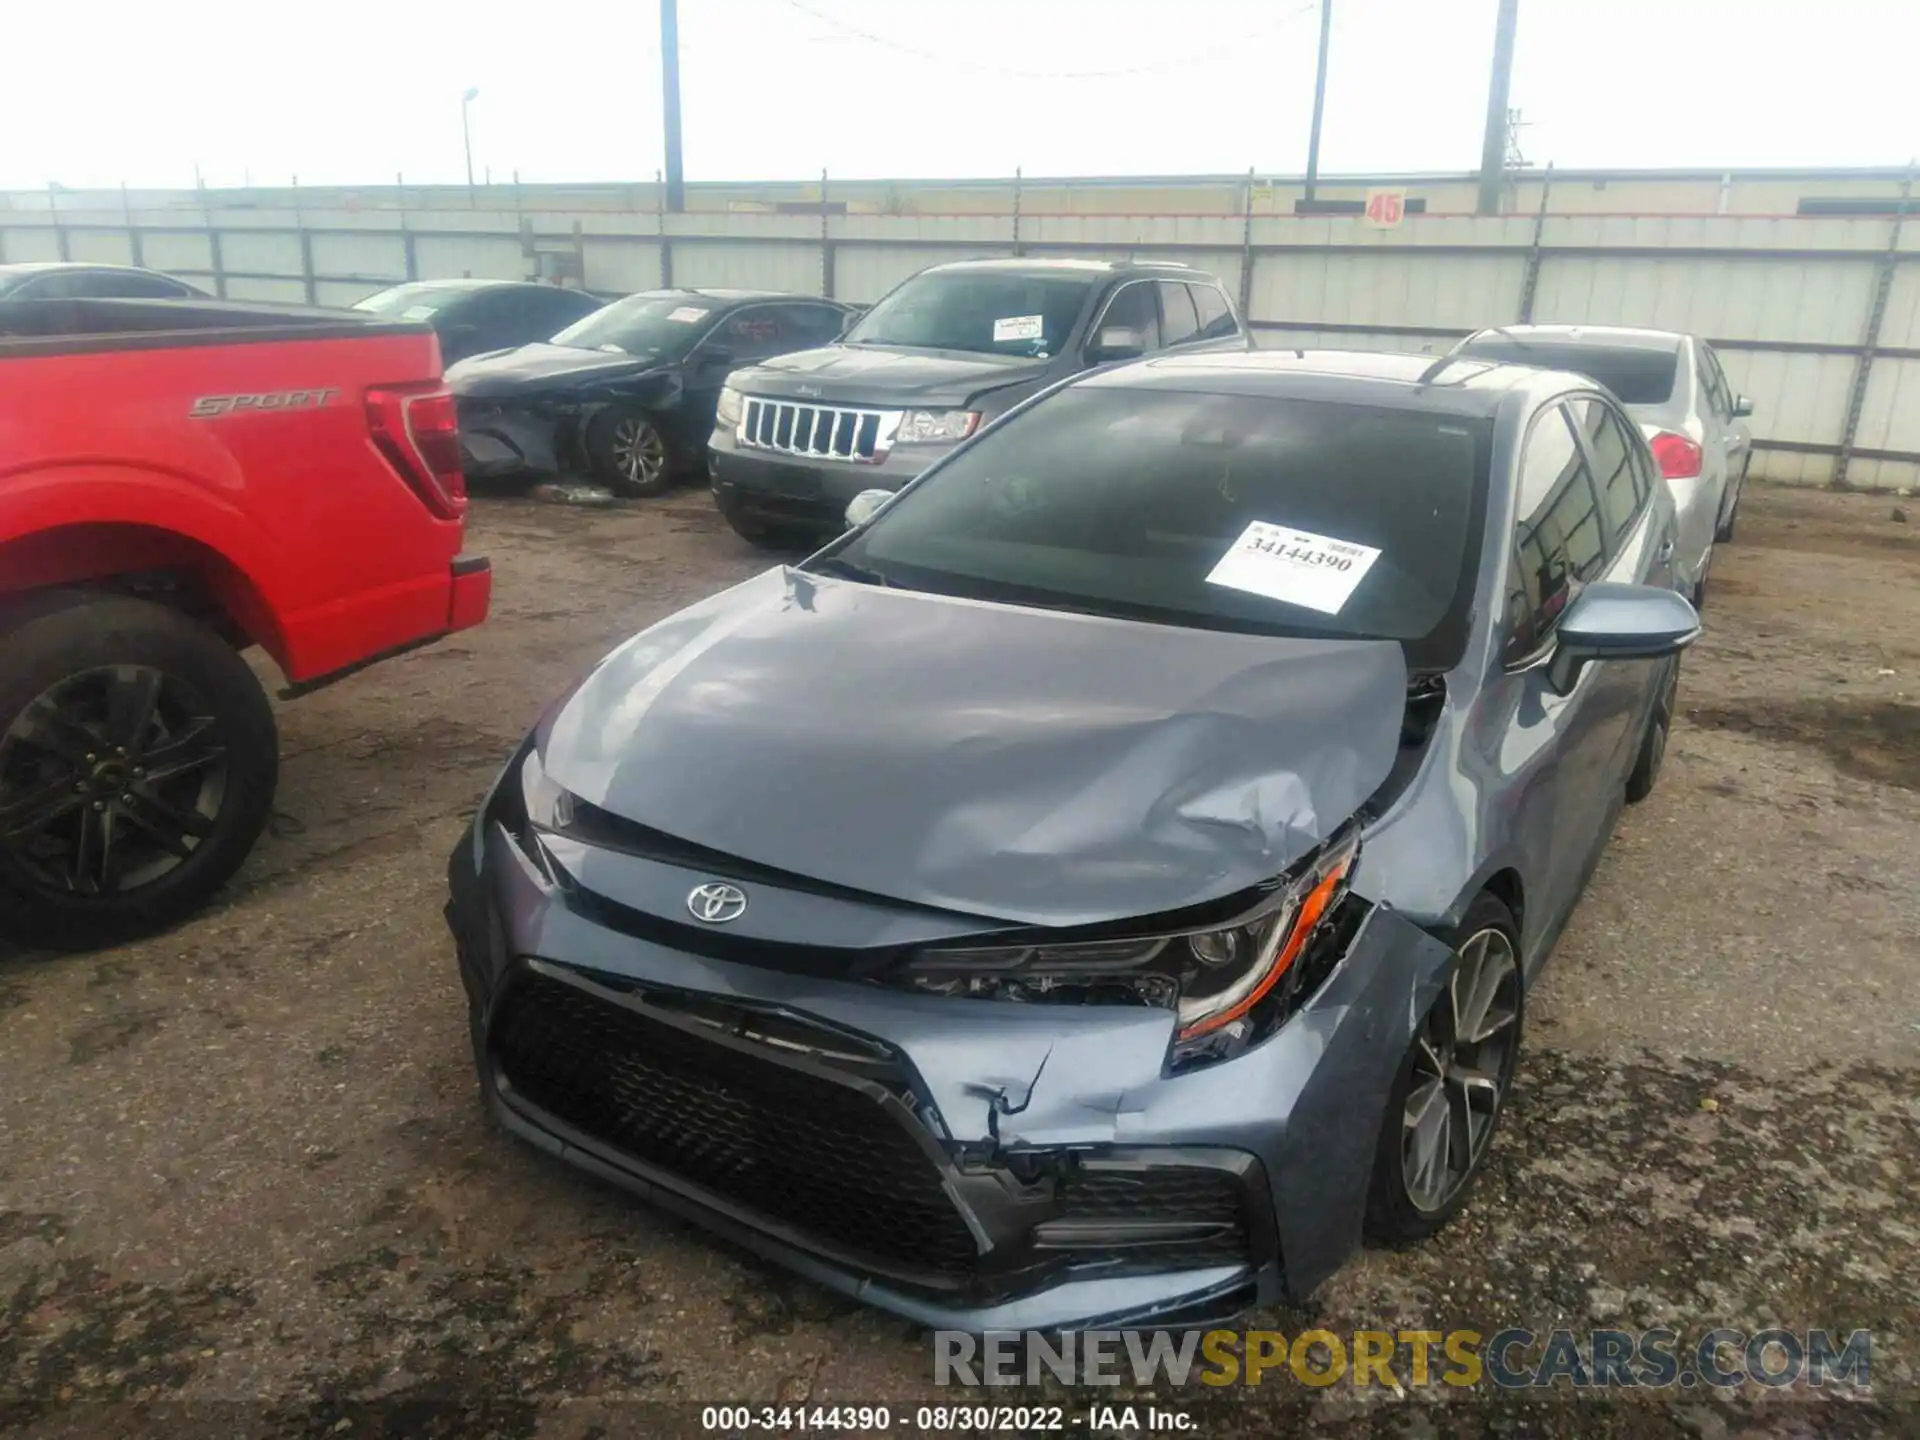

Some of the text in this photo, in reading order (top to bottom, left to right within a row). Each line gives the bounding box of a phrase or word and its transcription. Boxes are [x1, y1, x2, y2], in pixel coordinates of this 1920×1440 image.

[1368, 194, 1400, 223] 45
[188, 388, 341, 419] SPORT
[1246, 536, 1353, 572] 34144390
